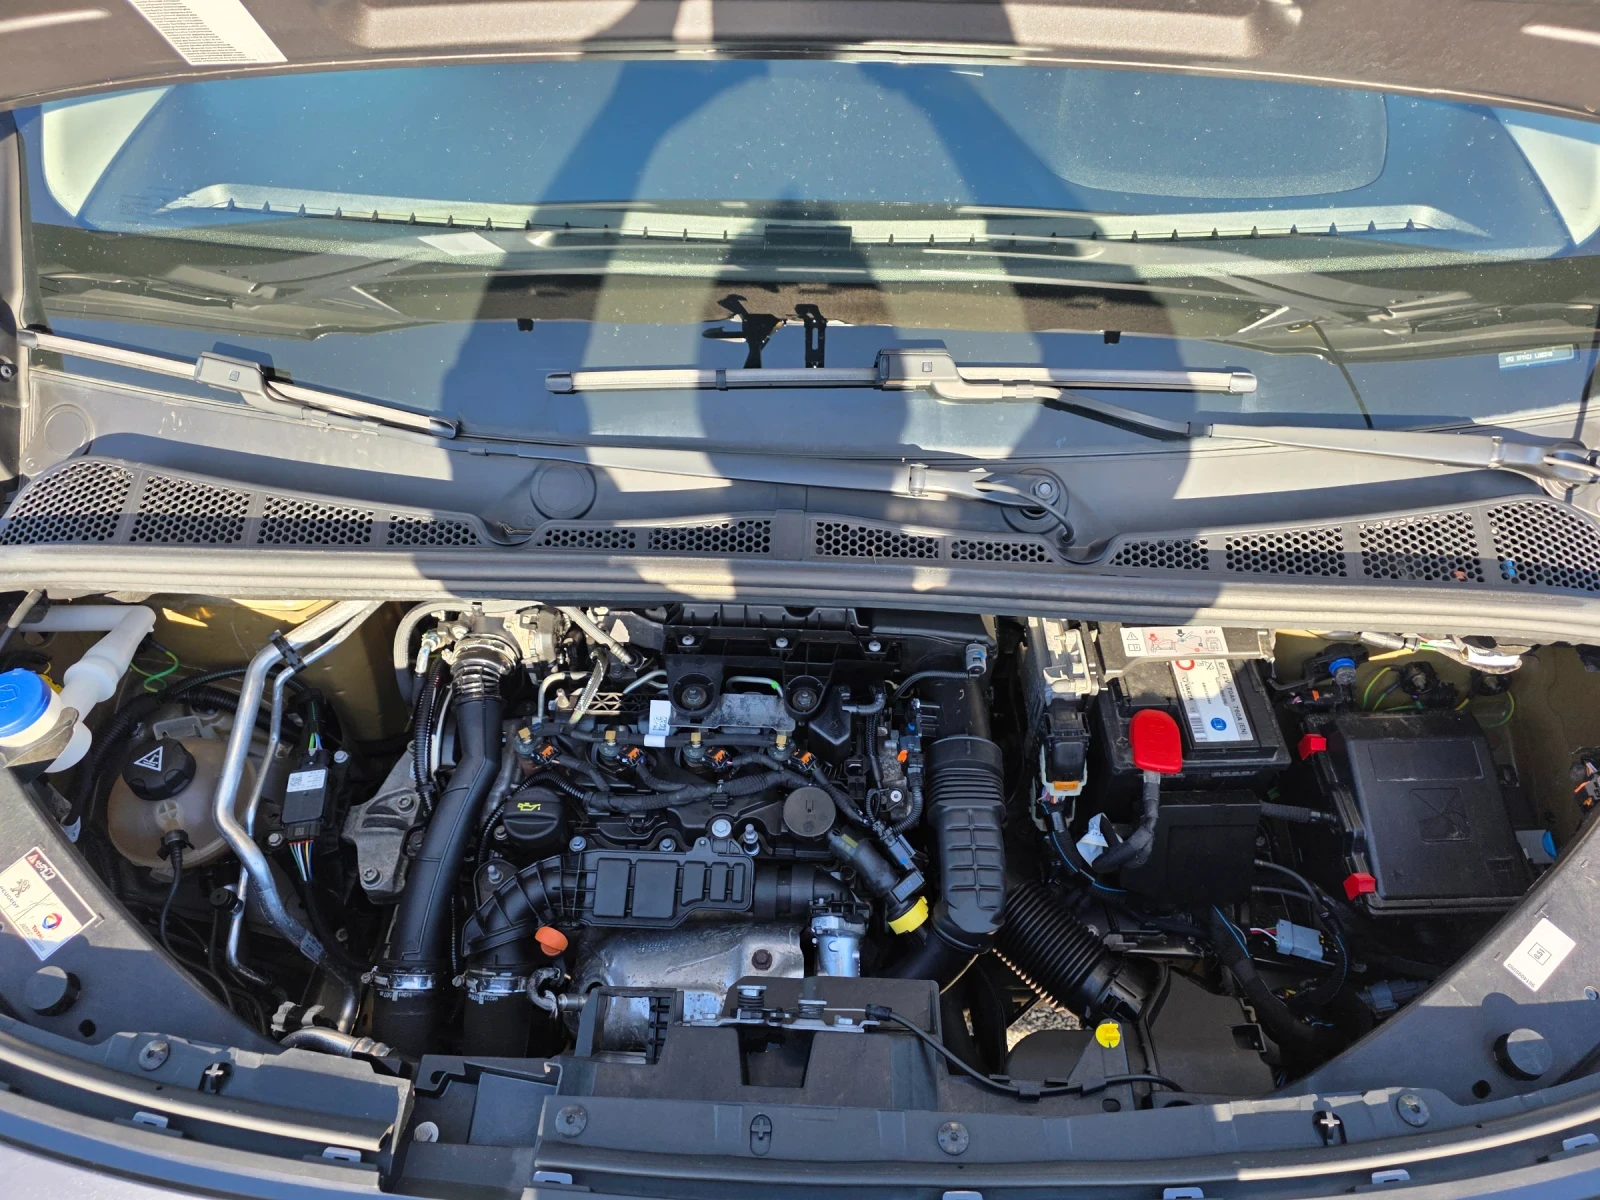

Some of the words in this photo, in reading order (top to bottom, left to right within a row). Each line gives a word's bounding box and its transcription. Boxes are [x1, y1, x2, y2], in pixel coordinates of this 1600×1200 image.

[1184, 682, 1194, 702] VARTA
[1222, 673, 1231, 684] 12V
[1227, 687, 1236, 702] 70Ah
[1233, 705, 1243, 722] 760A
[1238, 722, 1248, 735] (EN)
[0, 885, 19, 909] PEUGEOT
[31, 924, 44, 940] TOTAL
